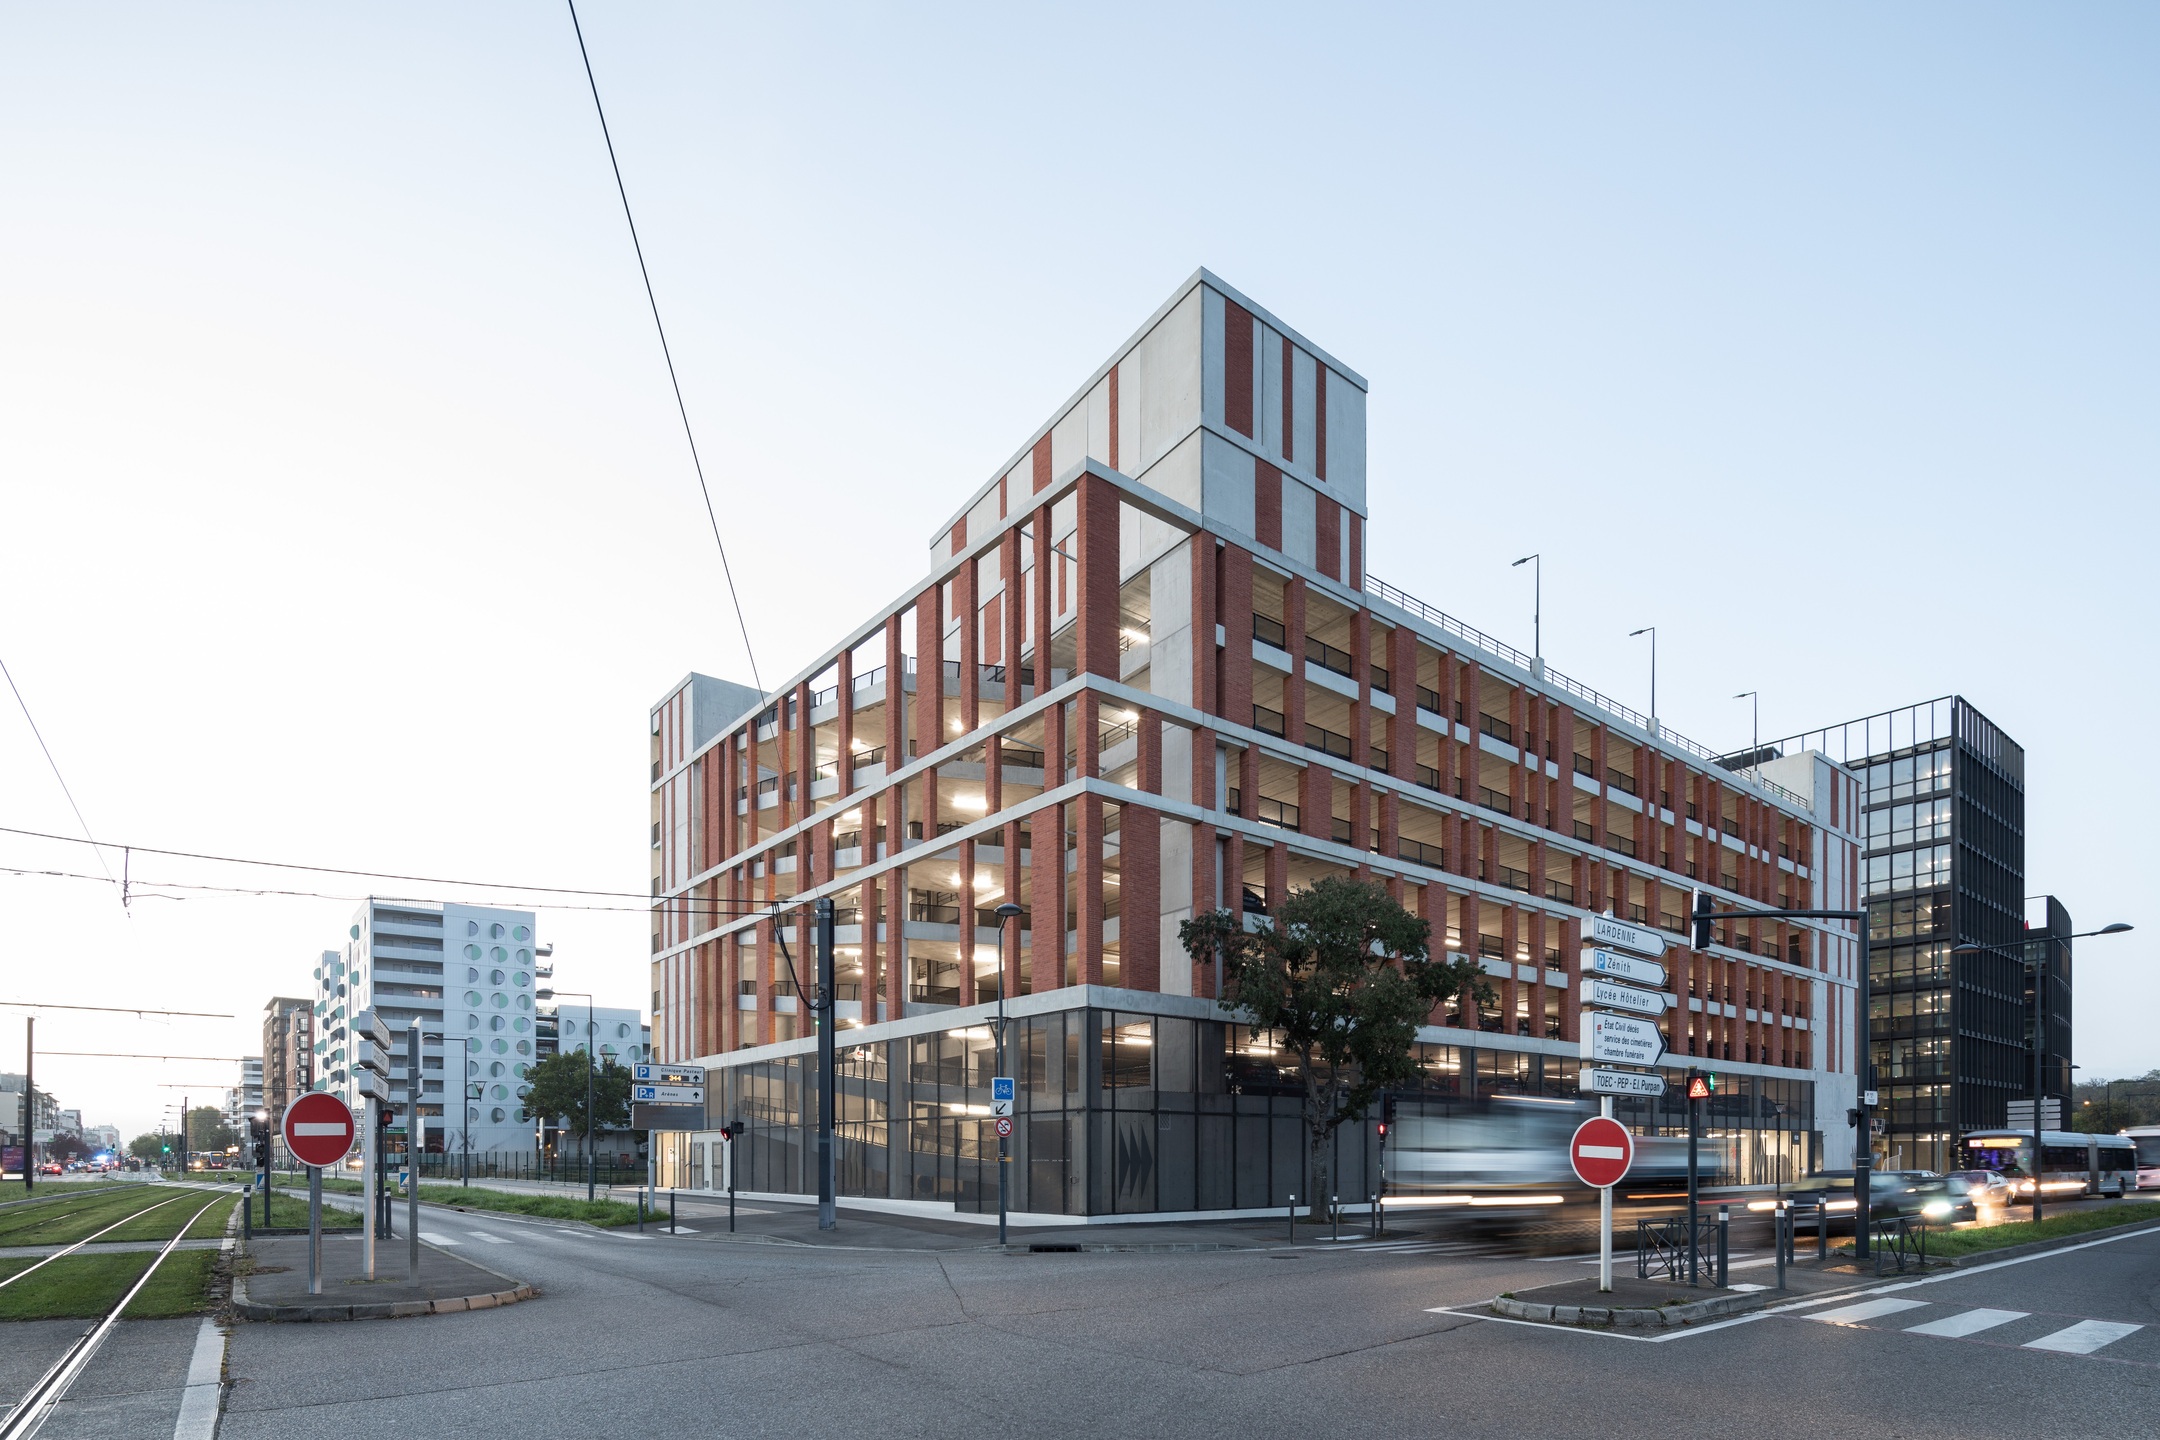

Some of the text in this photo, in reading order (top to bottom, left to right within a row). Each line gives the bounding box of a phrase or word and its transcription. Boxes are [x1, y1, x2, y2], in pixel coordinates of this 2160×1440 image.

[1597, 923, 1636, 943] LARDENNE
[1598, 953, 1631, 973] P Zénith
[1596, 986, 1649, 1007] Lycée Hôtelier
[1604, 1018, 1640, 1034] État Civil décès
[1604, 1035, 1653, 1049] service des cimetières
[1604, 1046, 1624, 1058] chambre
[1624, 1048, 1645, 1060] funéraire
[640, 1067, 647, 1077] P
[1597, 1075, 1613, 1088] TOEC
[1617, 1077, 1629, 1089] PEP
[1641, 1079, 1660, 1094] Purpan
